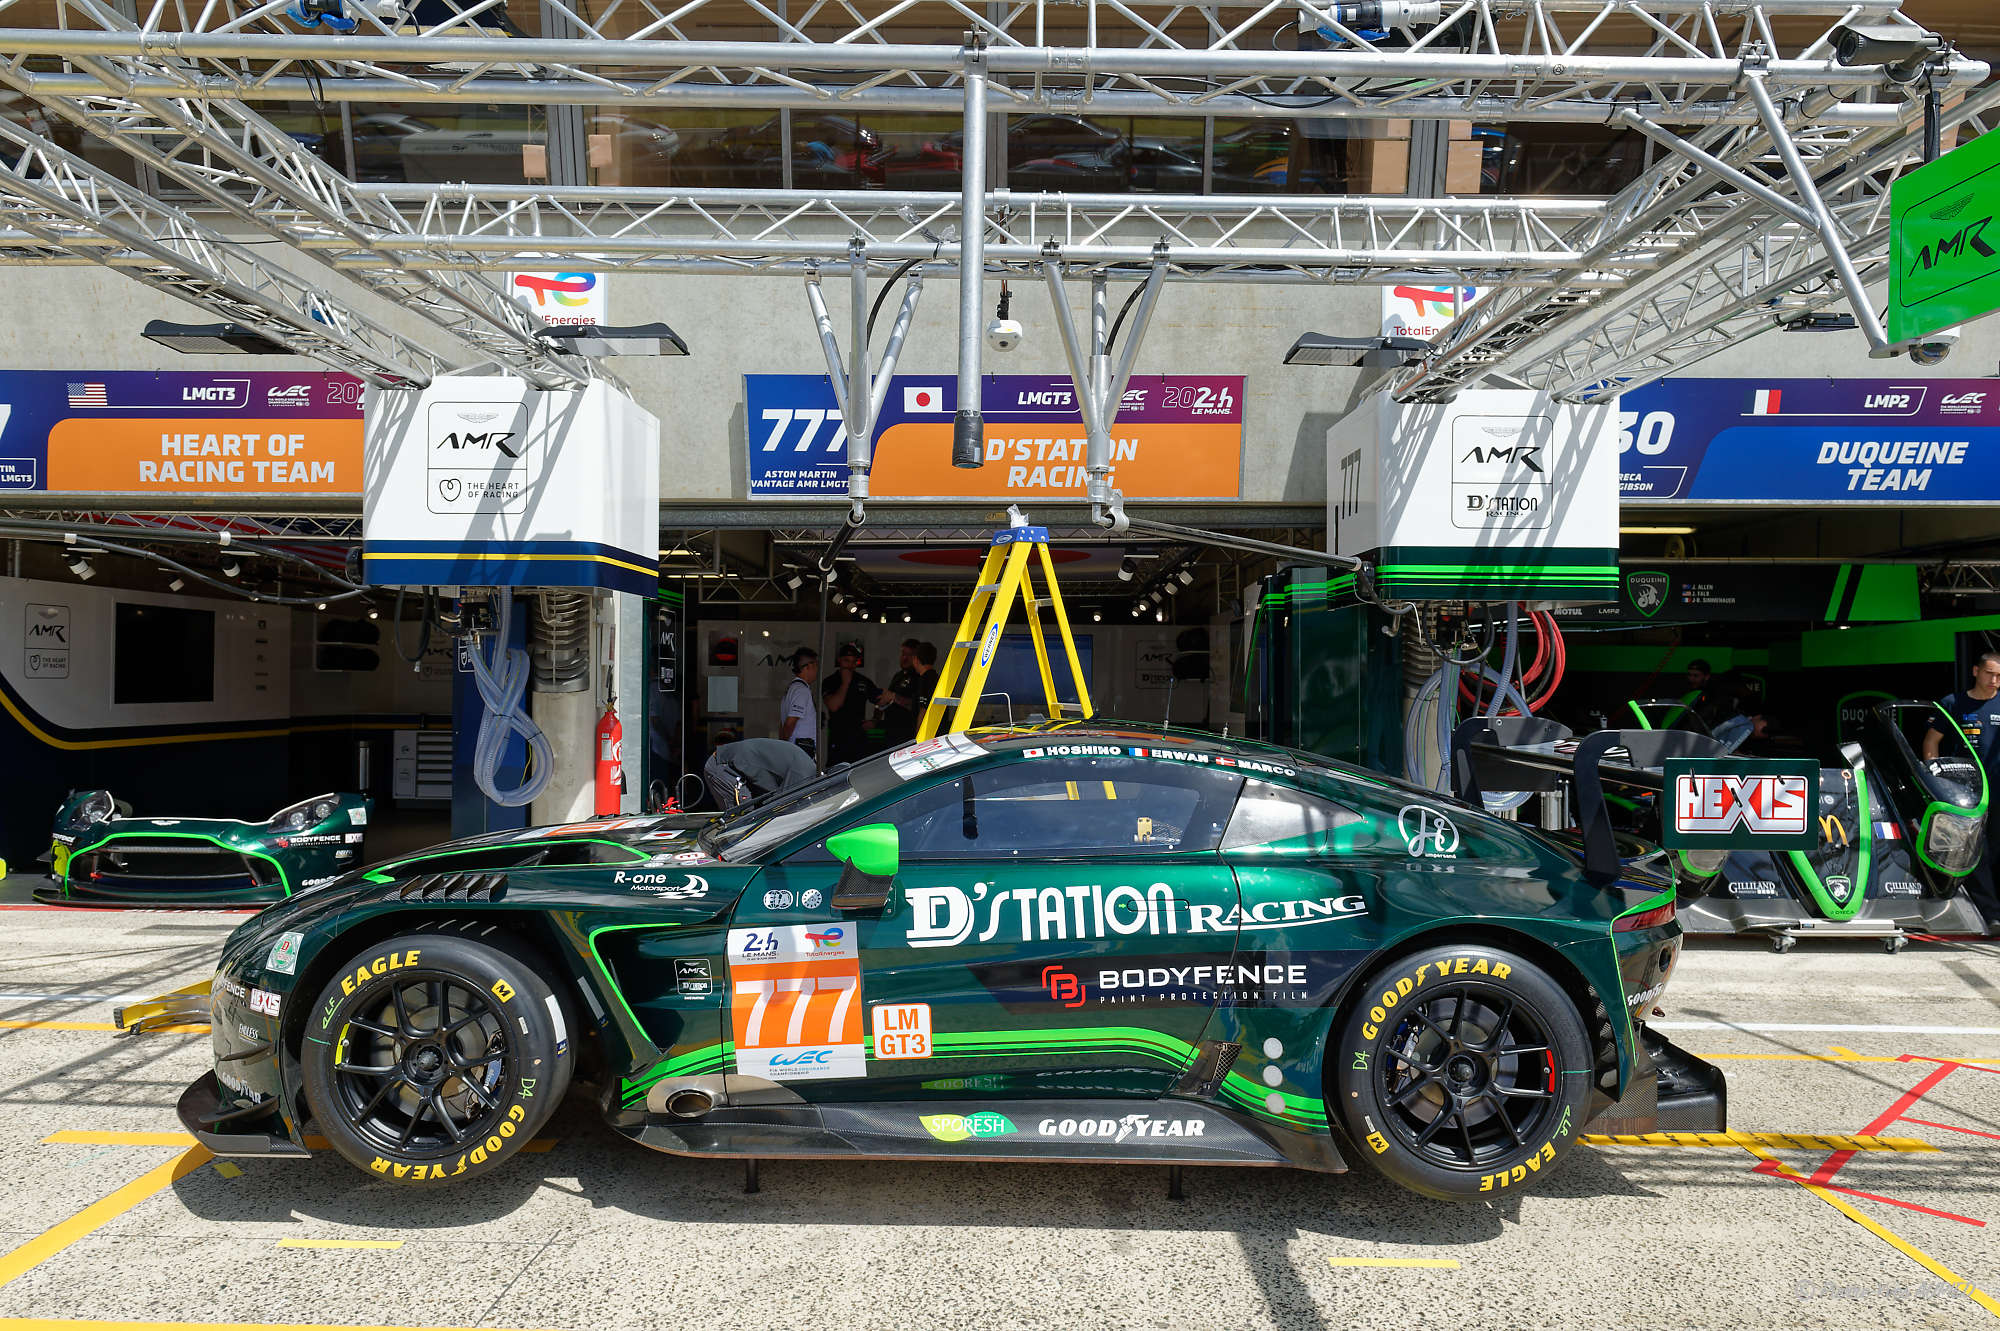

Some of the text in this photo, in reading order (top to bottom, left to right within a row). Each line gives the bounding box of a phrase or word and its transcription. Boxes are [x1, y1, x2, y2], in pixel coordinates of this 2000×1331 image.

[1908, 216, 1996, 278] AMR
[182, 387, 236, 401] LMGT3
[267, 385, 312, 397] WEC
[1017, 391, 1072, 405] LMGT3
[1121, 389, 1149, 401] EC
[1941, 392, 1987, 404] WEC
[1864, 394, 1910, 409] LMP2
[761, 408, 848, 452] 777
[161, 433, 305, 456] HEART OF
[437, 432, 519, 459] AMR
[985, 438, 1138, 461] D'STATN
[1816, 441, 1969, 465] DUQUEINE
[1461, 446, 1545, 473] AMR
[1, 474, 33, 483] LMGT3
[139, 461, 336, 483] RACING TEAM
[764, 470, 837, 479] ASTON MARTIN
[1847, 468, 1932, 491] TEAM
[467, 482, 519, 490] THE HEART
[751, 479, 795, 489] VANTAGE
[797, 480, 819, 488] AMR
[1553, 607, 1583, 616] MOTUL
[28, 624, 66, 643] AMR
[1046, 745, 1121, 757] HOSHINO
[1151, 749, 1209, 763] ERWAN
[1238, 759, 1296, 777] MARCO
[1678, 776, 1806, 832] HEXIS
[290, 835, 341, 844] BODYFENCE
[614, 870, 667, 885] R-one
[630, 884, 681, 892] Motorsport
[905, 882, 1177, 948] D'STATION
[1187, 895, 1368, 934] RACING
[753, 949, 778, 957] MANS
[340, 949, 422, 997] EAGLE
[678, 967, 709, 976] AMR
[1099, 964, 1308, 989] BODYFENCE
[251, 988, 281, 1016] HEXIS
[1100, 990, 1308, 1004] PAINT PROTECTION FILM
[1361, 957, 1513, 1041] GOODYEAR
[735, 975, 858, 1047] 777
[884, 1008, 919, 1031] LM
[880, 1033, 926, 1056] GT3
[768, 1050, 833, 1066] WEC
[930, 1117, 1005, 1136] SPORESH
[1038, 1114, 1206, 1144] GOODYEAR
[370, 1104, 526, 1181] GOODYEAR
[1479, 1141, 1557, 1193] EAGLE
